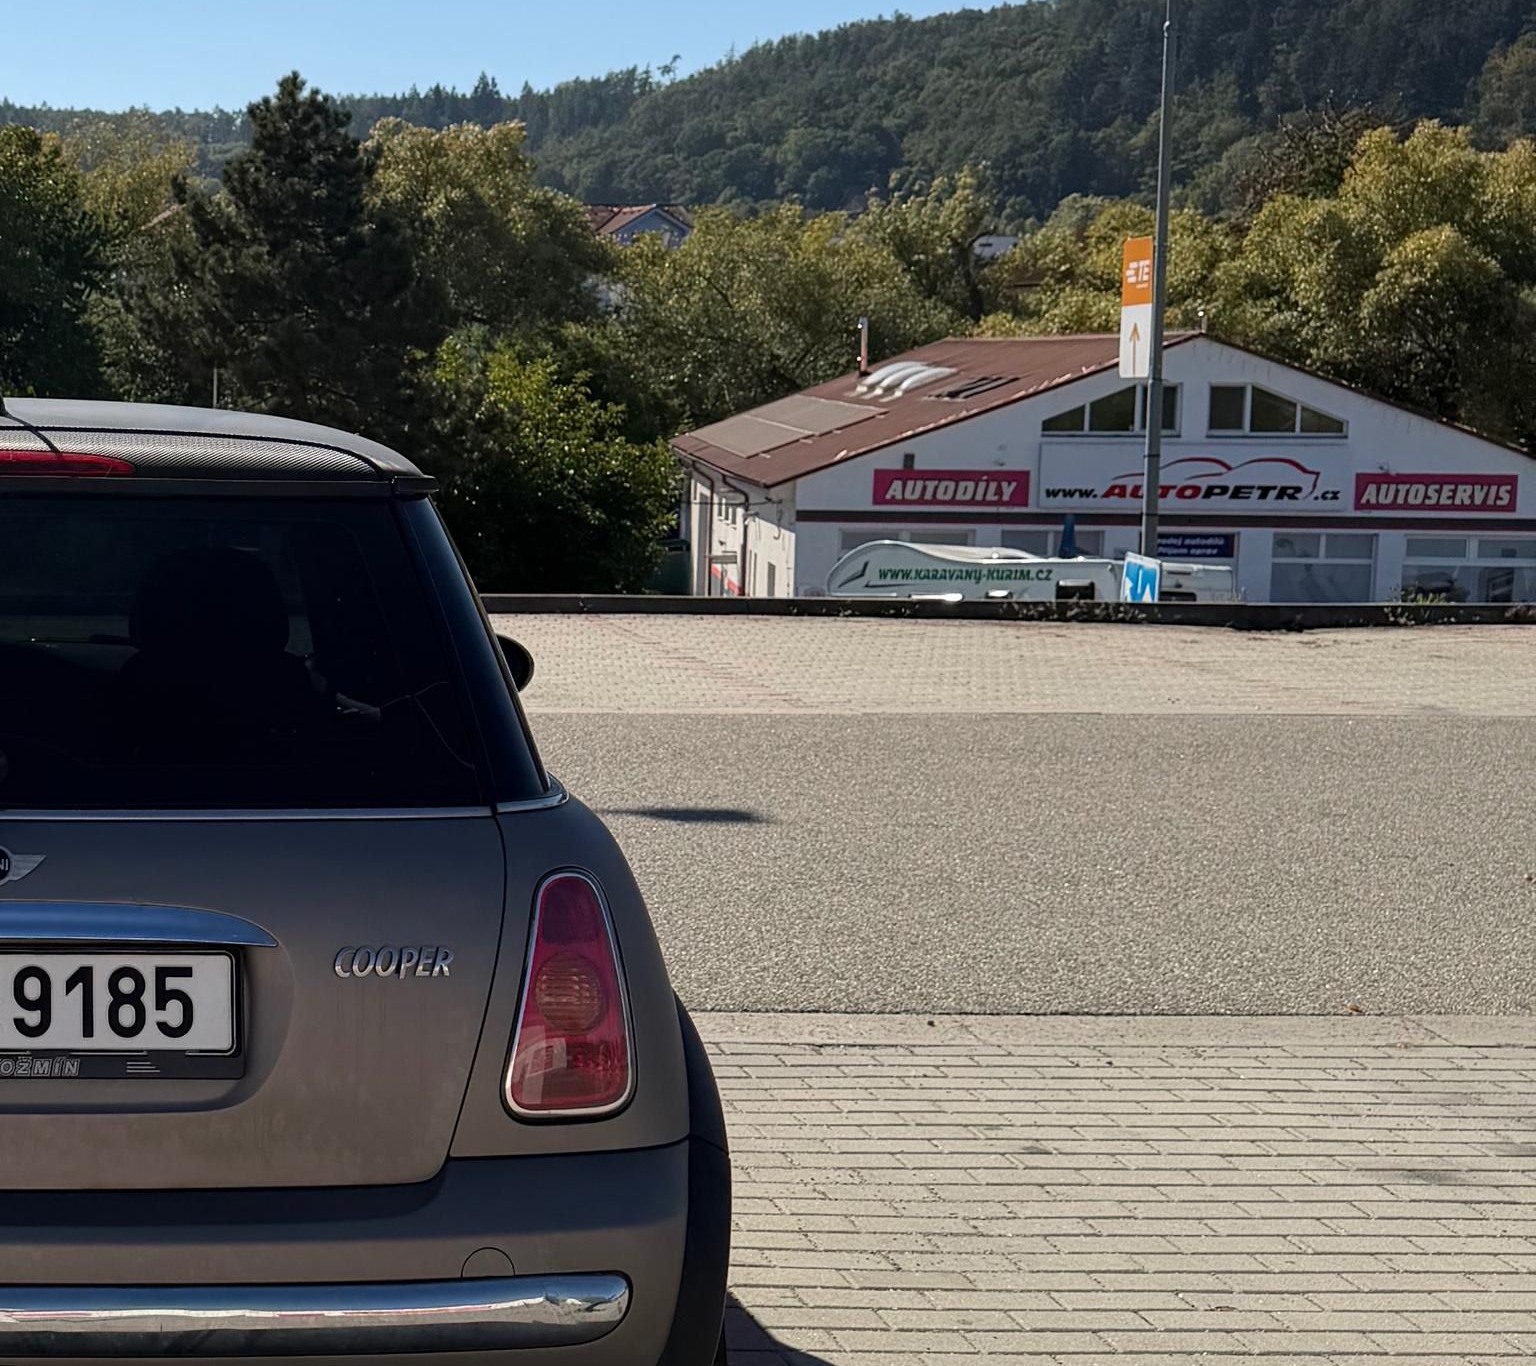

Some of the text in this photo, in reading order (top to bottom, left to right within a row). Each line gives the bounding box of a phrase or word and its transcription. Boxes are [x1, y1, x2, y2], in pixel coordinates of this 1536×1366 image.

[884, 475, 1018, 502] AUTODÍLY
[1360, 483, 1512, 506] AUTOSERVIS
[334, 945, 455, 979] COOPER
[12, 965, 194, 1038] 9185
